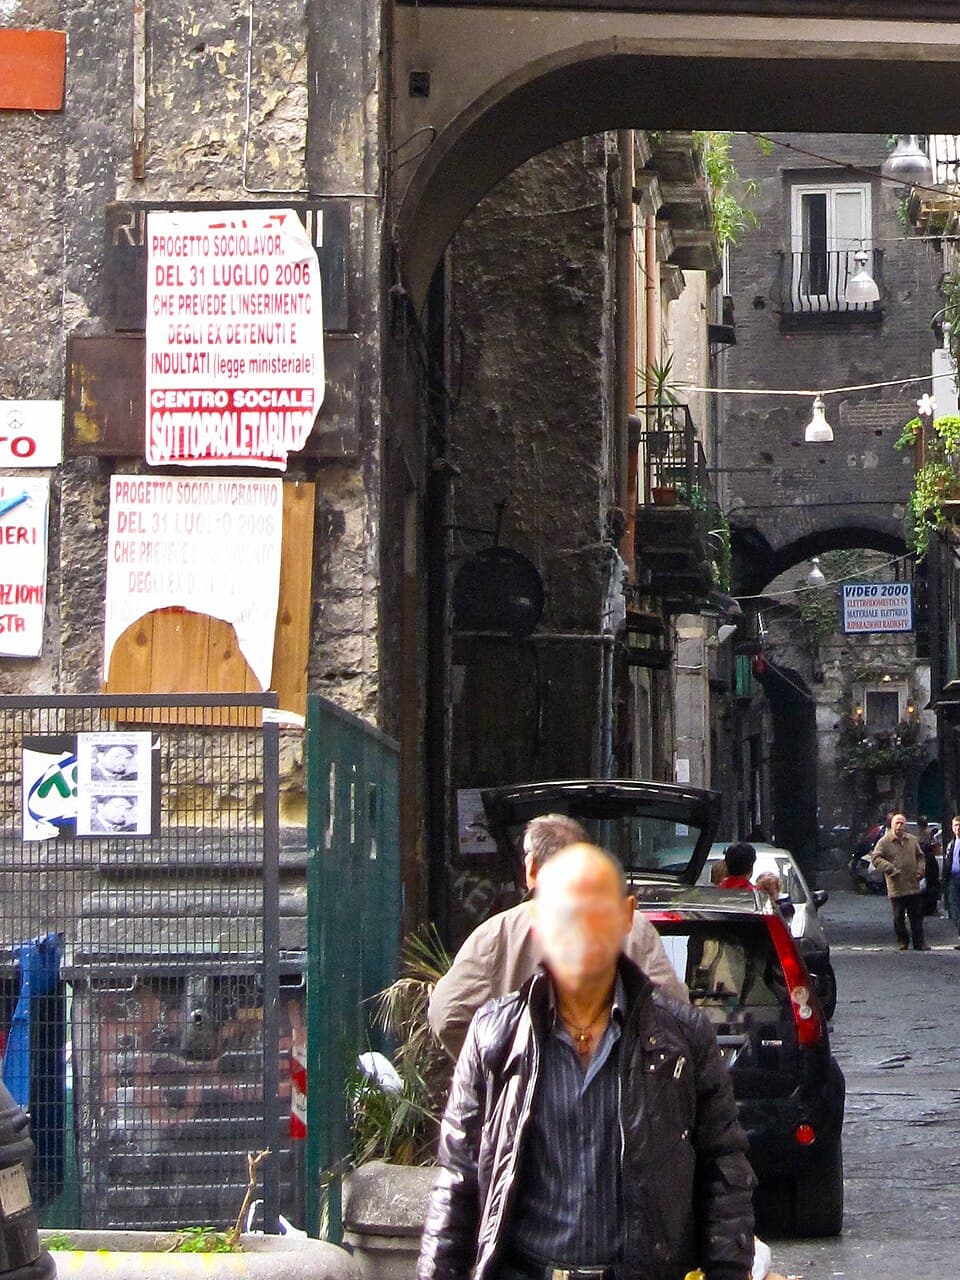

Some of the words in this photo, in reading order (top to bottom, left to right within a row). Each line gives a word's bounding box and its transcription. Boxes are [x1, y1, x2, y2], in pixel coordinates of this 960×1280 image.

[152, 235, 209, 257] PROGETTO
[155, 265, 184, 287] DEL
[190, 265, 205, 286] 31
[213, 264, 269, 287] LUGLIO
[275, 263, 310, 286] 2006
[153, 294, 174, 316] CHE
[178, 294, 226, 316] PREVEDE
[168, 323, 203, 345] DEGLI
[207, 323, 222, 345] EX
[226, 322, 286, 345] DETENUTI
[290, 322, 297, 345] E
[151, 352, 210, 375] INDULTATI
[213, 353, 245, 379] (legge
[151, 390, 229, 408] CENTRO
[233, 389, 314, 408] SOCIALE
[115, 481, 173, 504] PROGETTO
[176, 481, 278, 507] SOCIOLAVORATIVO
[117, 511, 146, 534] DEL
[152, 512, 168, 534] 31
[114, 541, 135, 563] CHE
[845, 586, 878, 597] VIDEO
[881, 585, 908, 596] 2000
